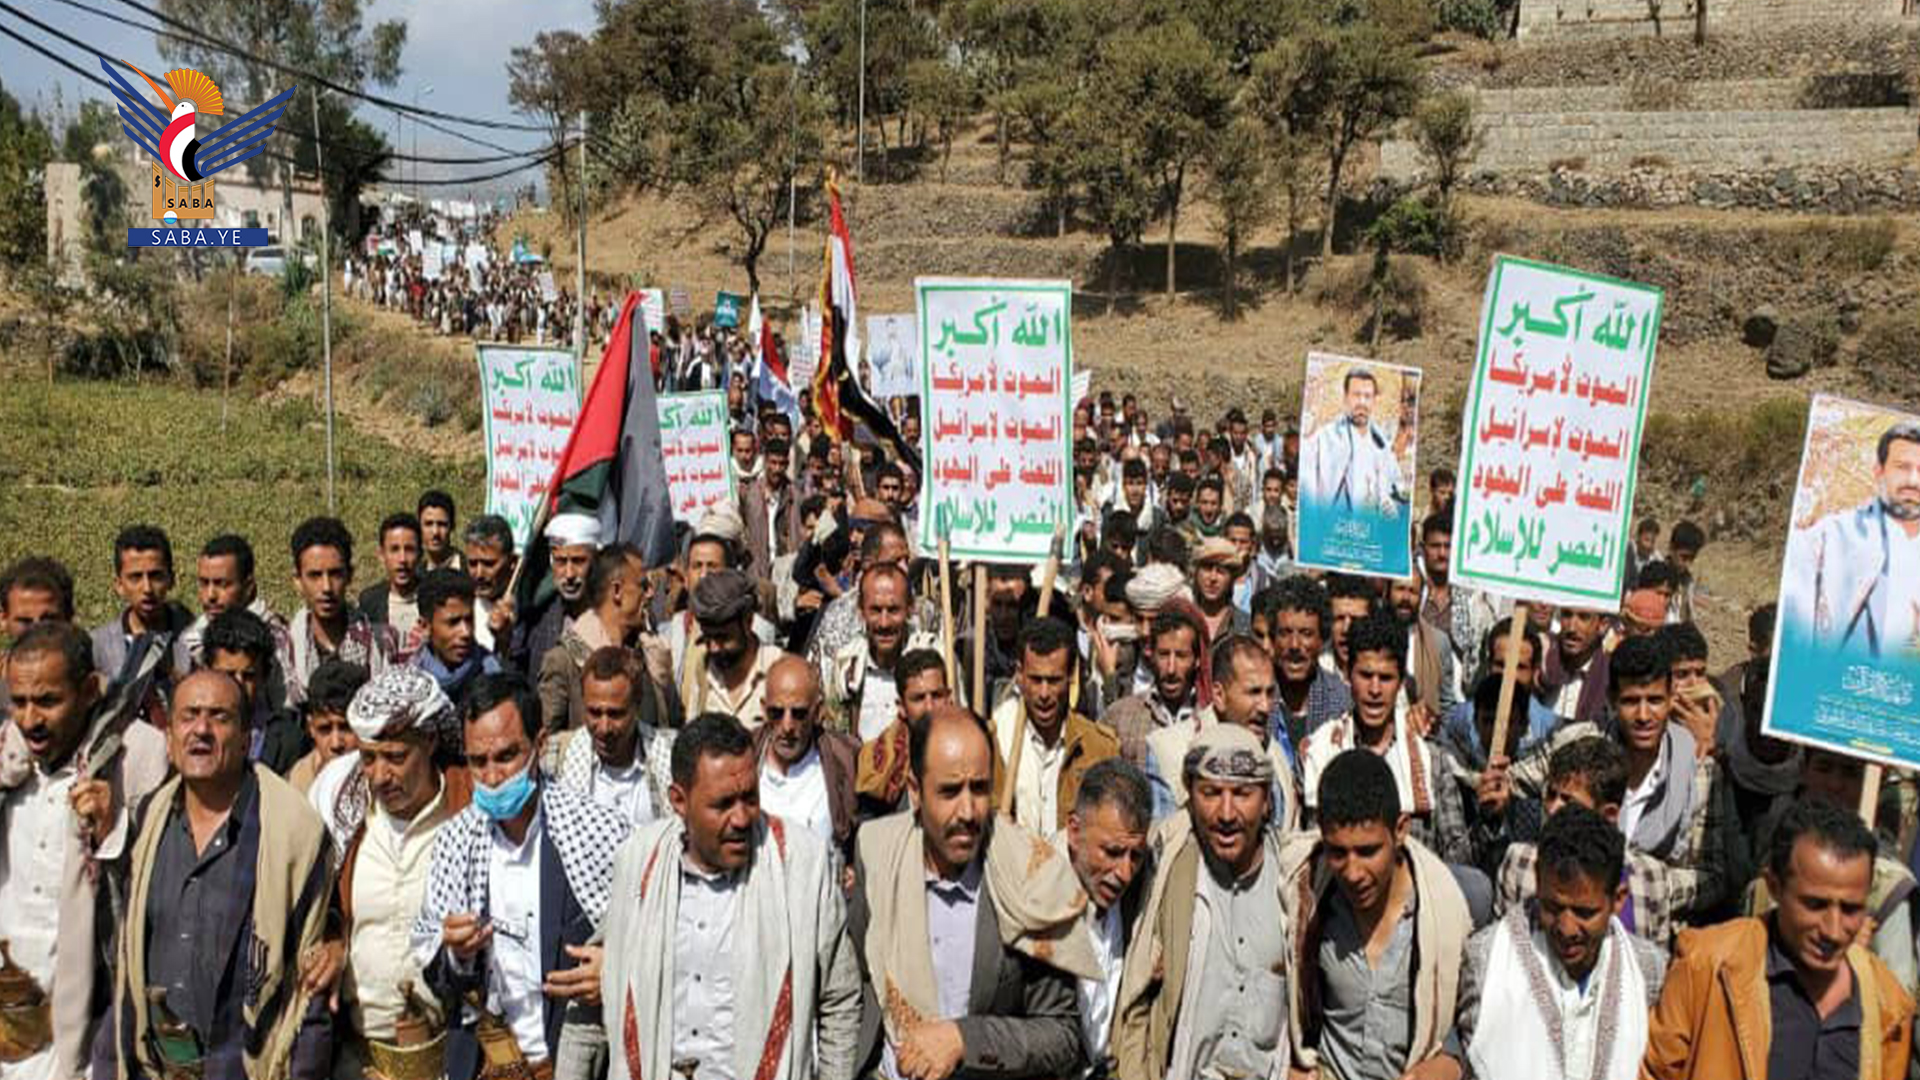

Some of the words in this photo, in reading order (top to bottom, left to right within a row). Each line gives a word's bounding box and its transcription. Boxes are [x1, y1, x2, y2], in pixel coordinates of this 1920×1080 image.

[931, 294, 1008, 358] أكبر
[1011, 303, 1062, 347] الله
[1496, 284, 1595, 348] أكبر
[1592, 302, 1650, 349] الله
[541, 360, 575, 393] الله
[1003, 364, 1062, 400] الموت
[1575, 372, 1638, 408] الموت
[689, 401, 721, 427] الله
[1004, 413, 1062, 446] الموت
[1568, 426, 1630, 462] الموت
[933, 454, 979, 488] اليهود
[985, 456, 1011, 491] على
[1019, 453, 1062, 488] اللعنة
[1473, 462, 1531, 504] اليهود
[1534, 469, 1567, 509] على
[1574, 470, 1623, 513] اللعنة
[1466, 508, 1546, 573] للإسلام
[1546, 522, 1617, 576] النصر
